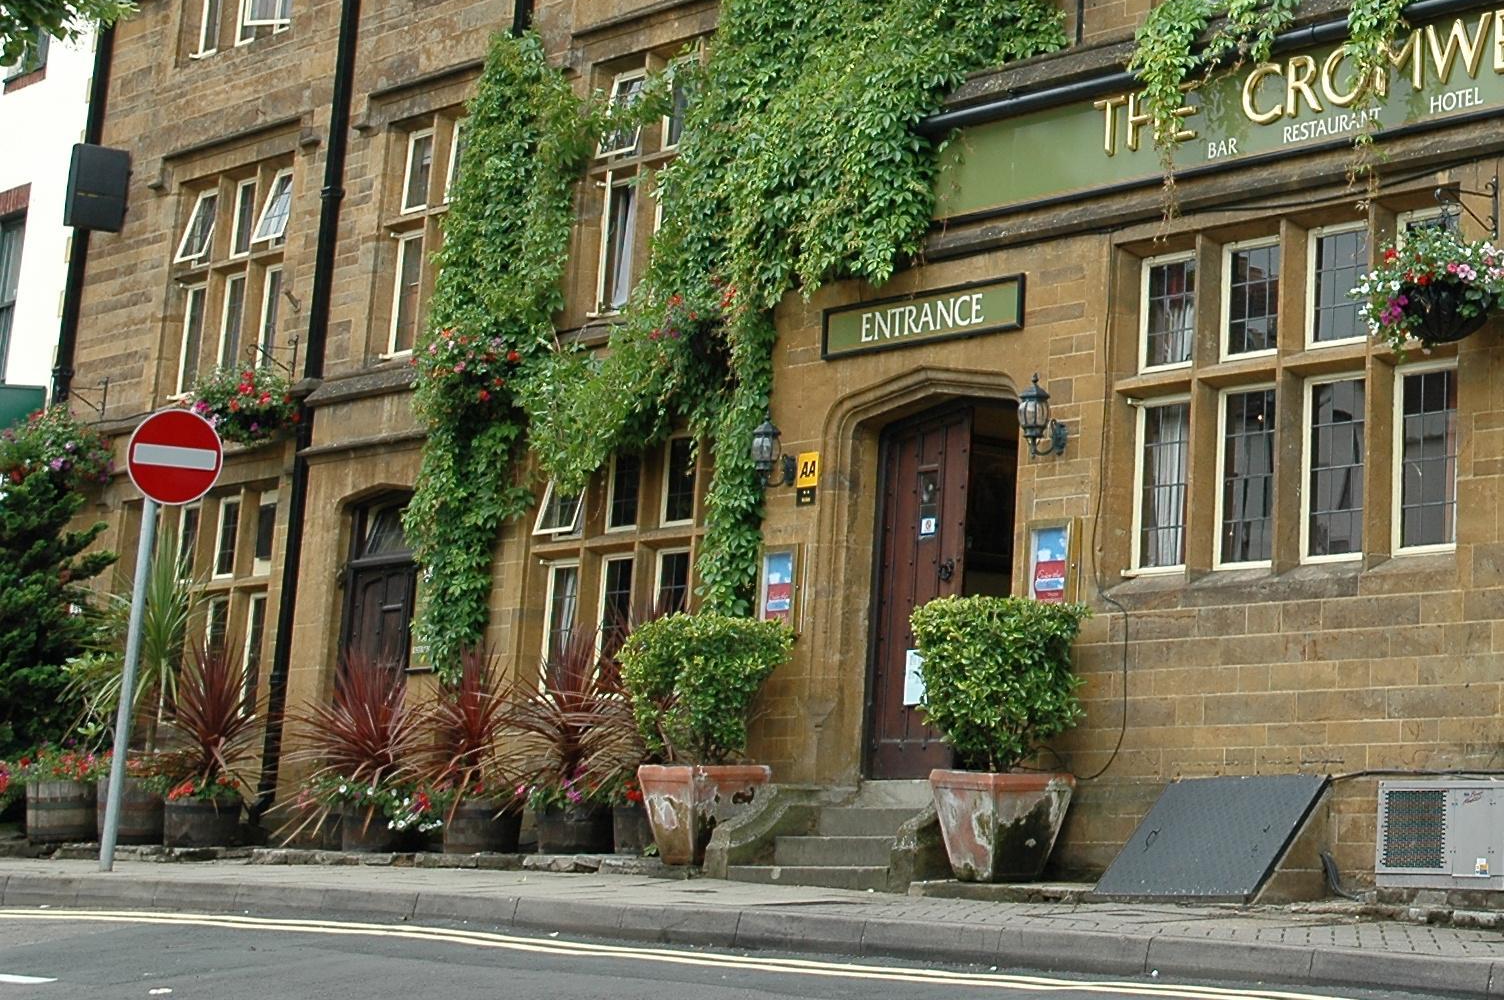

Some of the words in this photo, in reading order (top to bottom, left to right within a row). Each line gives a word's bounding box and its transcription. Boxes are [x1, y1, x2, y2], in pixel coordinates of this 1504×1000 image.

[1094, 81, 1199, 157] THE
[1207, 137, 1238, 159] BAR
[1283, 107, 1382, 143] RESTAURANT
[1429, 86, 1484, 114] HOTEL
[861, 293, 984, 343] ENTRANCE
[800, 460, 816, 479] AA
